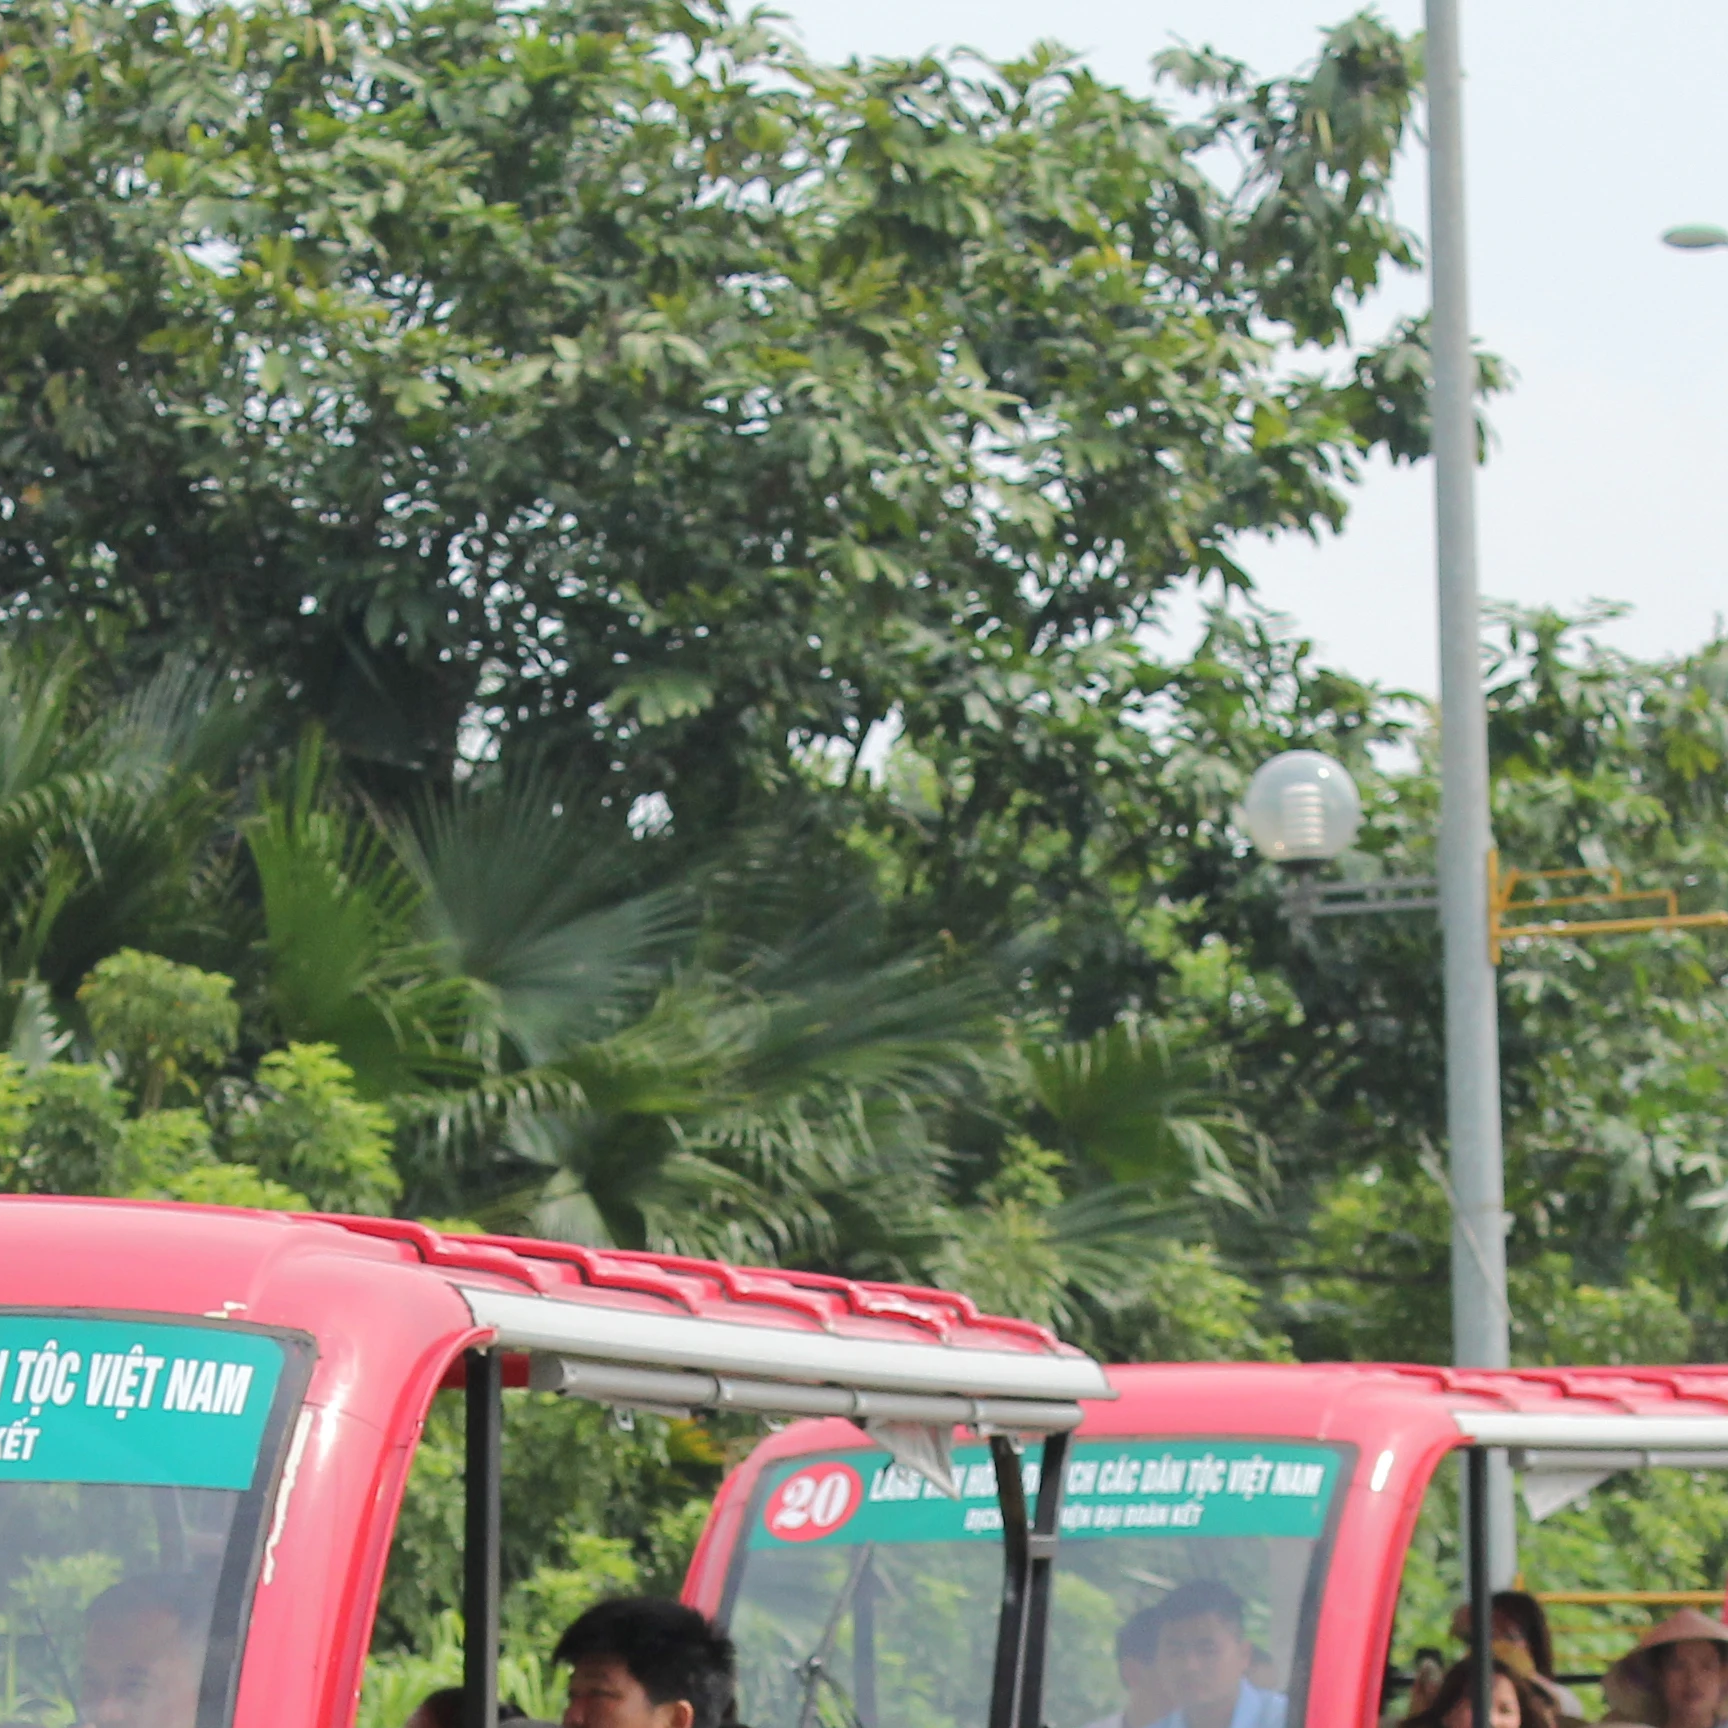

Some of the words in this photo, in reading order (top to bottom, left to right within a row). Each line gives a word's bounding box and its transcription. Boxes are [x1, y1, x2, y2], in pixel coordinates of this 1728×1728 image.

[12, 1339, 81, 1416] TỘC
[84, 1344, 165, 1420] VIỆT
[162, 1358, 255, 1416] NAM
[773, 1471, 851, 1529] 20
